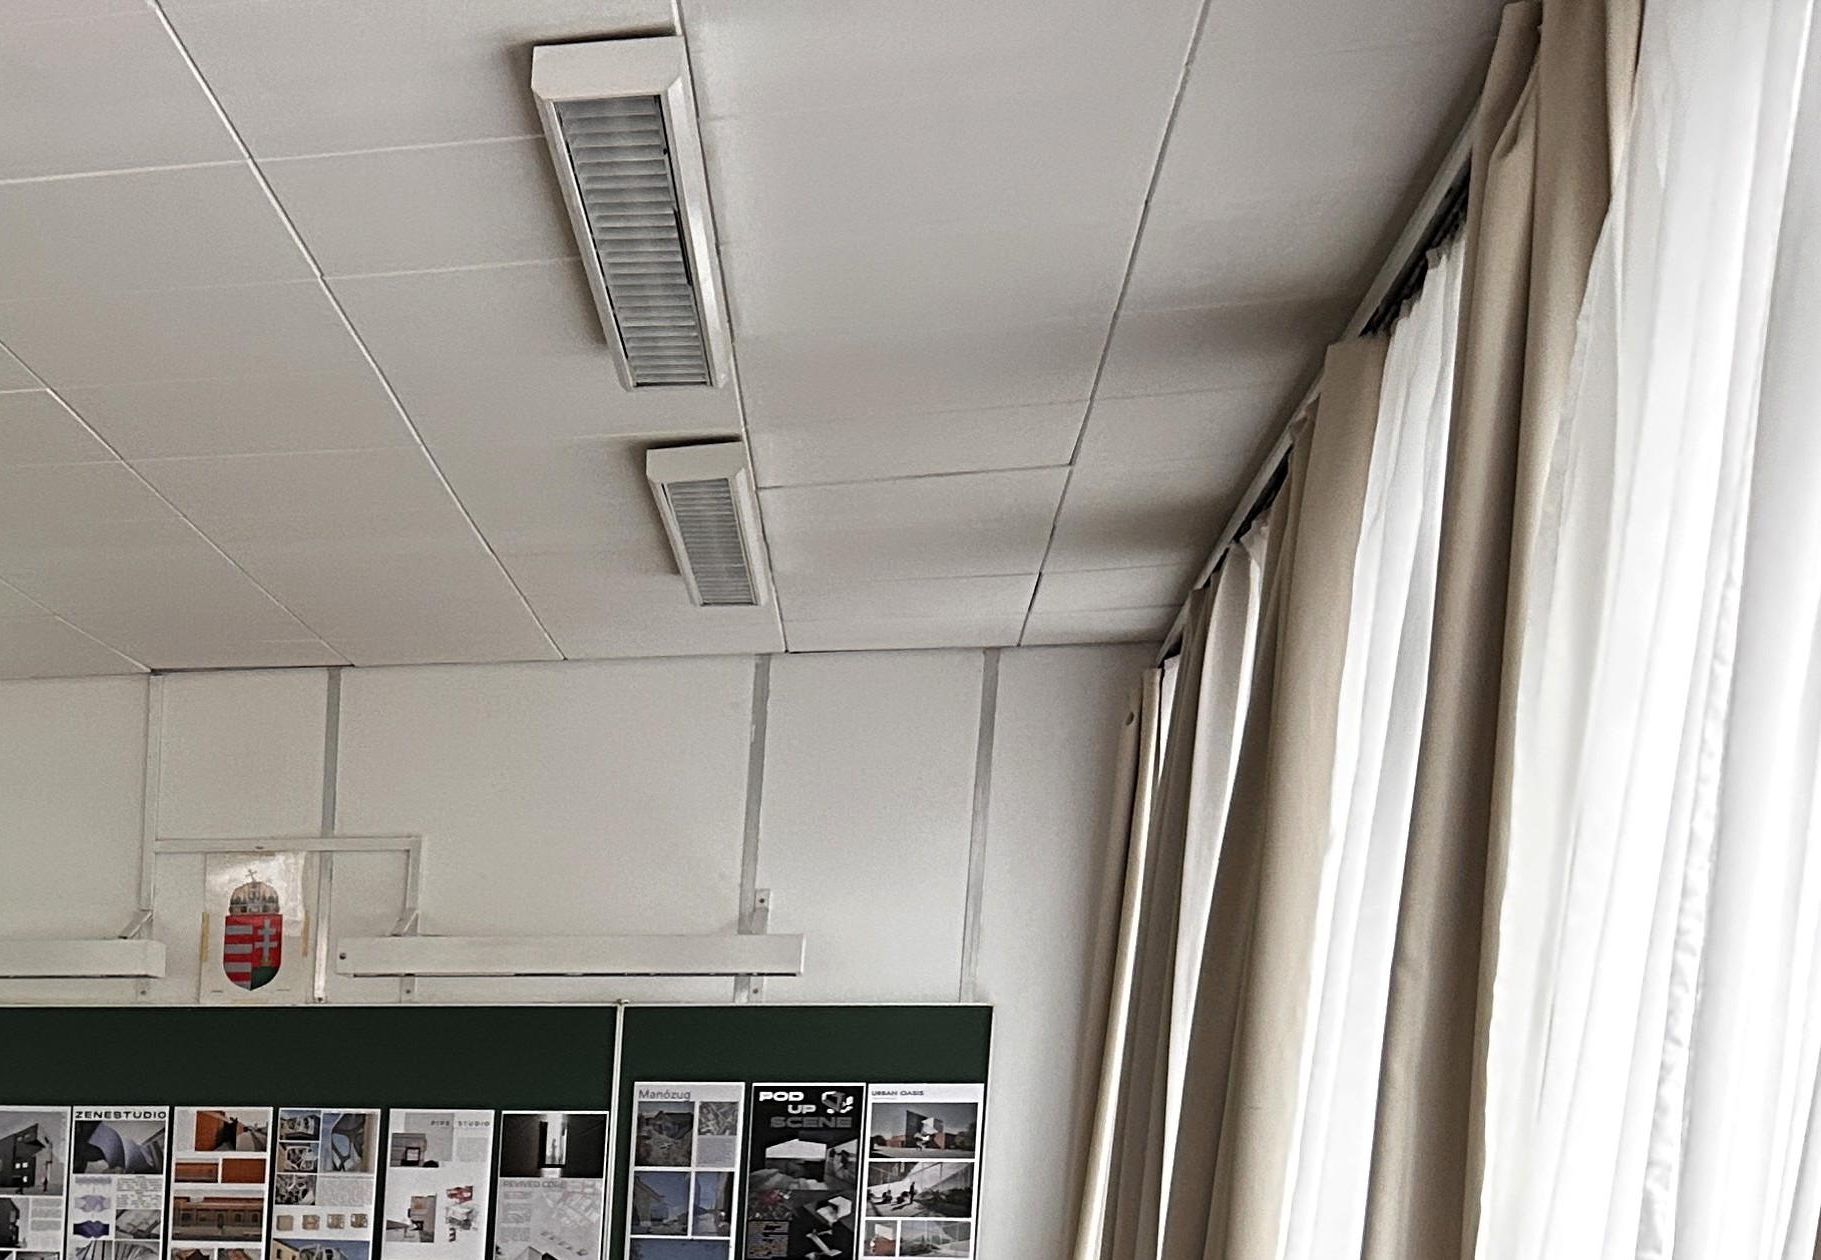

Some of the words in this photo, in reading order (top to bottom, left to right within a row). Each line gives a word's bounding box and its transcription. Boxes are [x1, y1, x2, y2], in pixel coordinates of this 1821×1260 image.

[758, 1091, 804, 1102] POD
[75, 1111, 167, 1119] ZENESTUDIO
[787, 1104, 817, 1115] UP
[770, 1116, 853, 1128] SCENE
